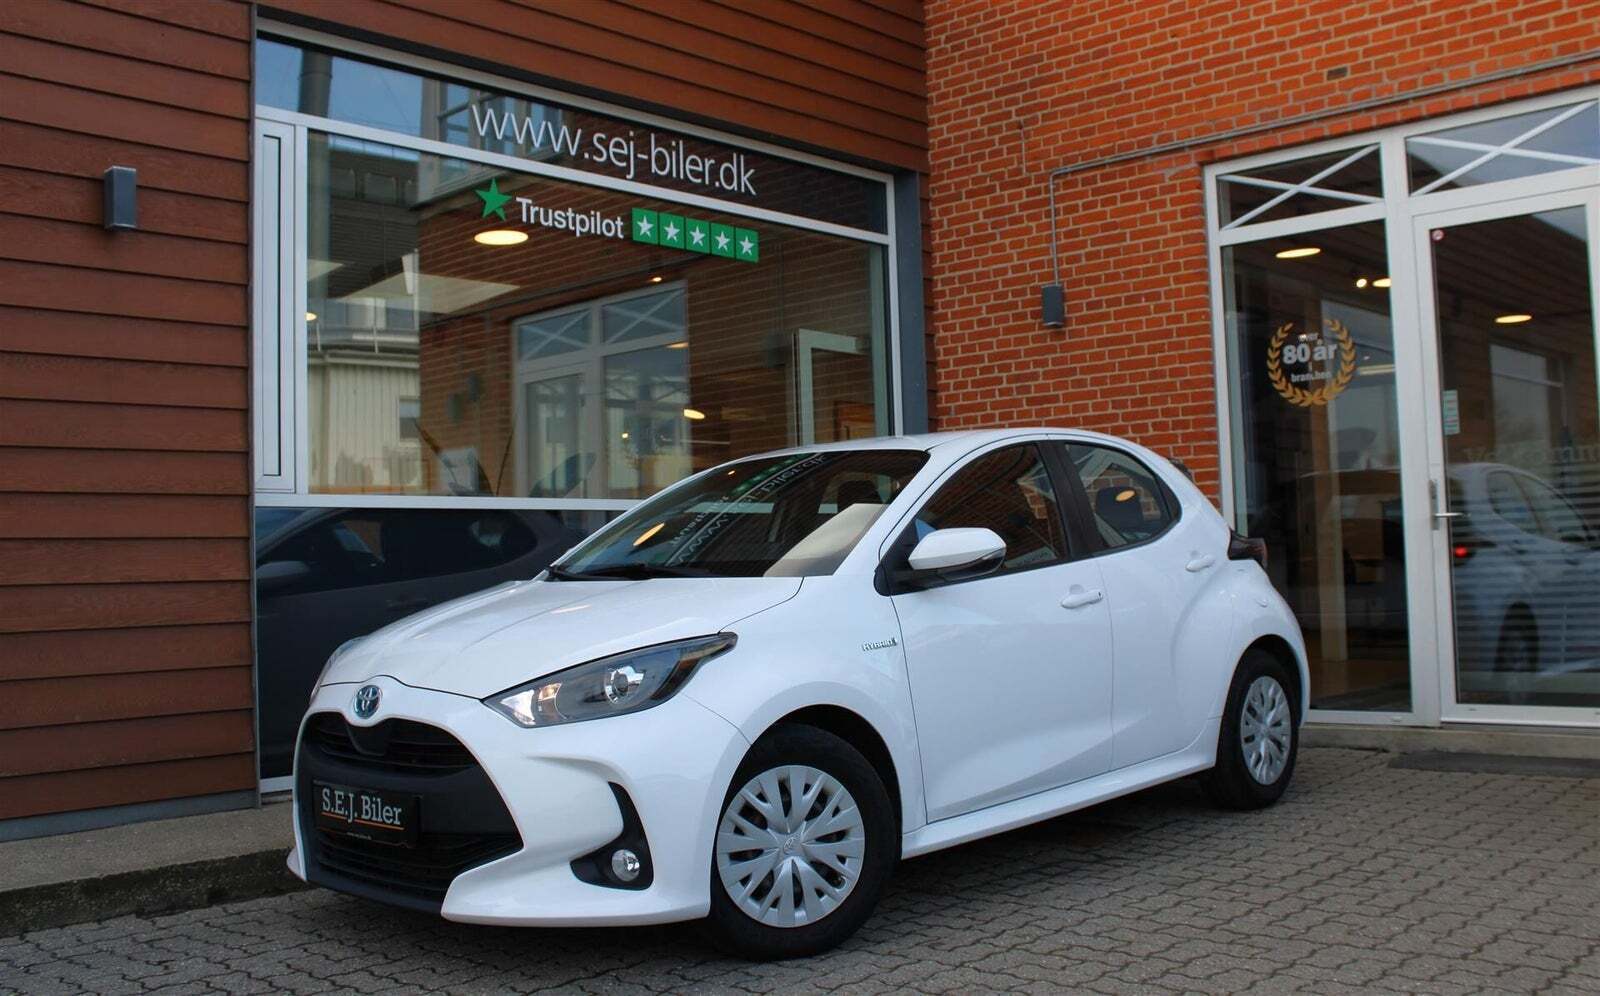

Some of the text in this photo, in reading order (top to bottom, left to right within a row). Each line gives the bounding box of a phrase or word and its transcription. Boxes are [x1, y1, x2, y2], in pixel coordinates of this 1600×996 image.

[471, 103, 757, 196] www.sej-biler.dk
[515, 196, 625, 240] Trustpilot
[1282, 339, 1338, 365] 80 år
[321, 787, 402, 825] S.E.J. Biler
